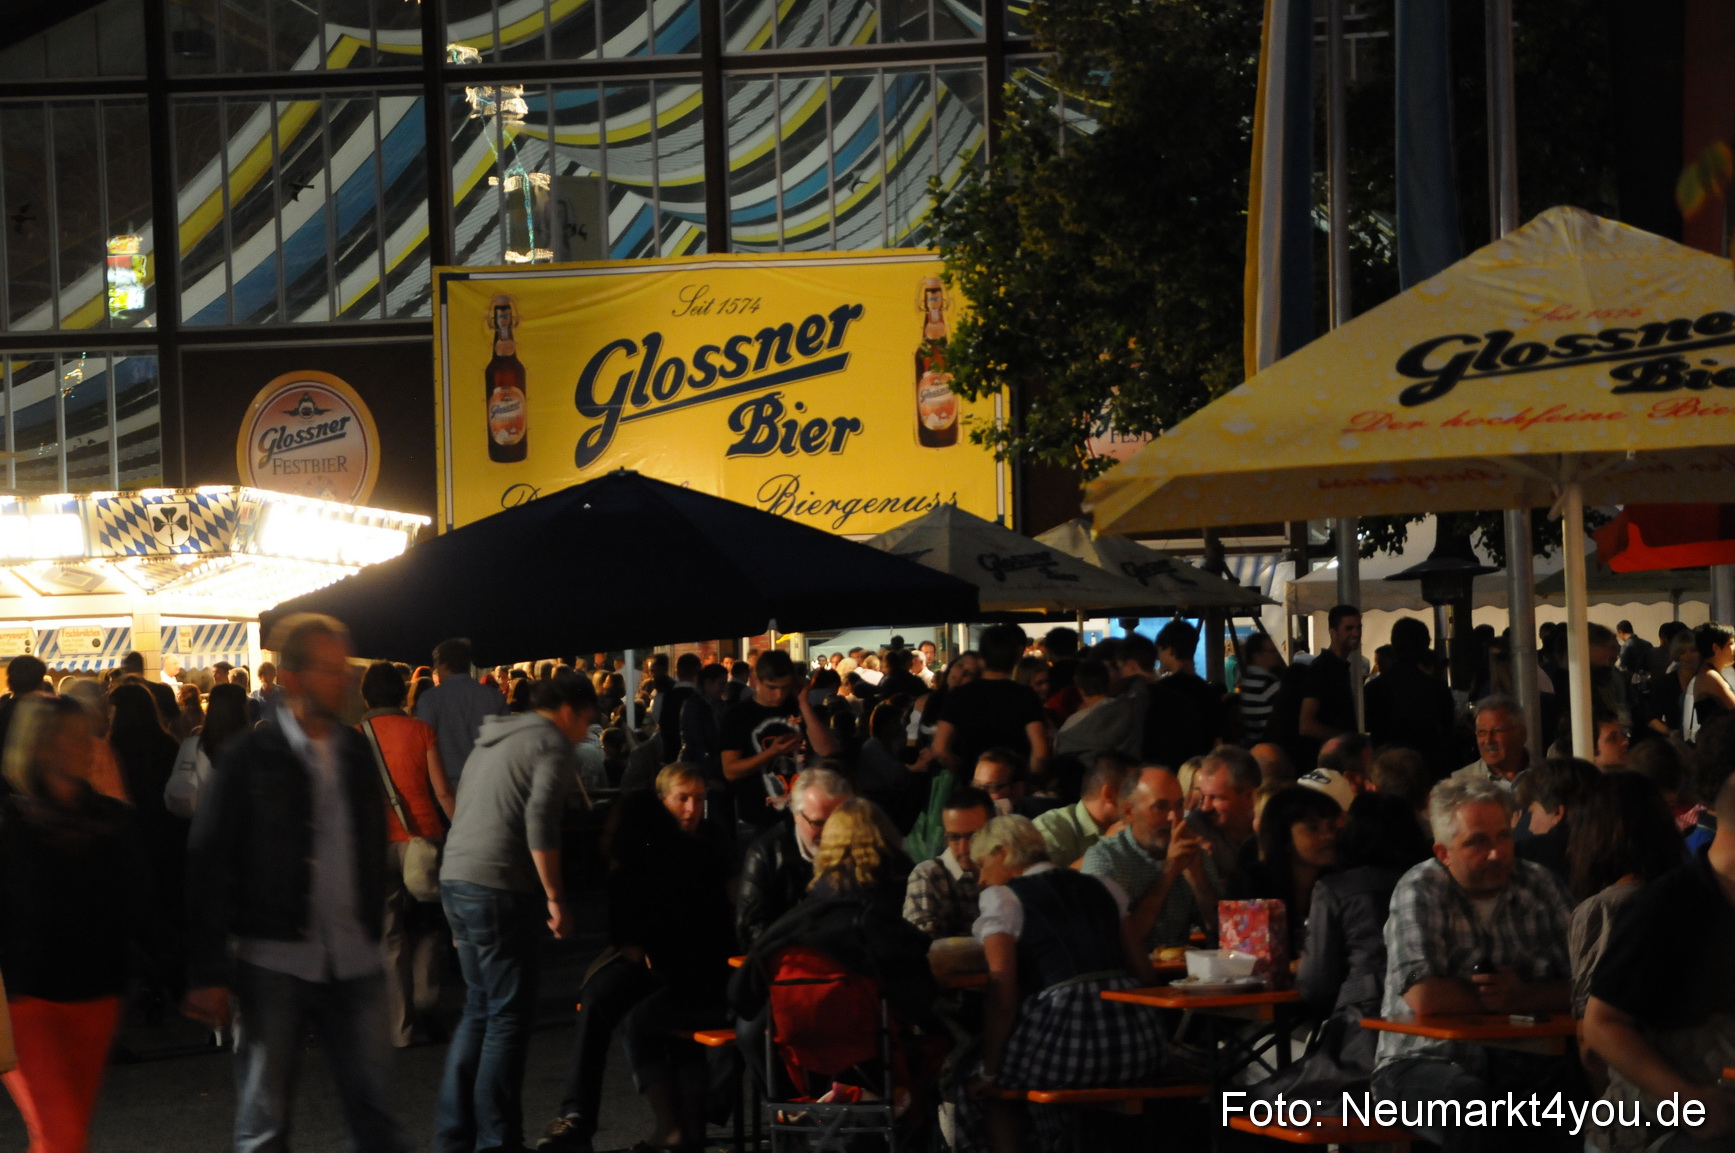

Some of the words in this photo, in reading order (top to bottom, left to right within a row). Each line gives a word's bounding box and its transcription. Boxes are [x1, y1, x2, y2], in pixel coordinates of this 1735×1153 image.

[671, 284, 715, 317] Seit
[716, 297, 762, 314] 1574
[574, 303, 864, 471] Glossner
[258, 416, 350, 469] Glossner
[725, 391, 863, 459] Bier
[757, 473, 958, 530] Biergenuss
